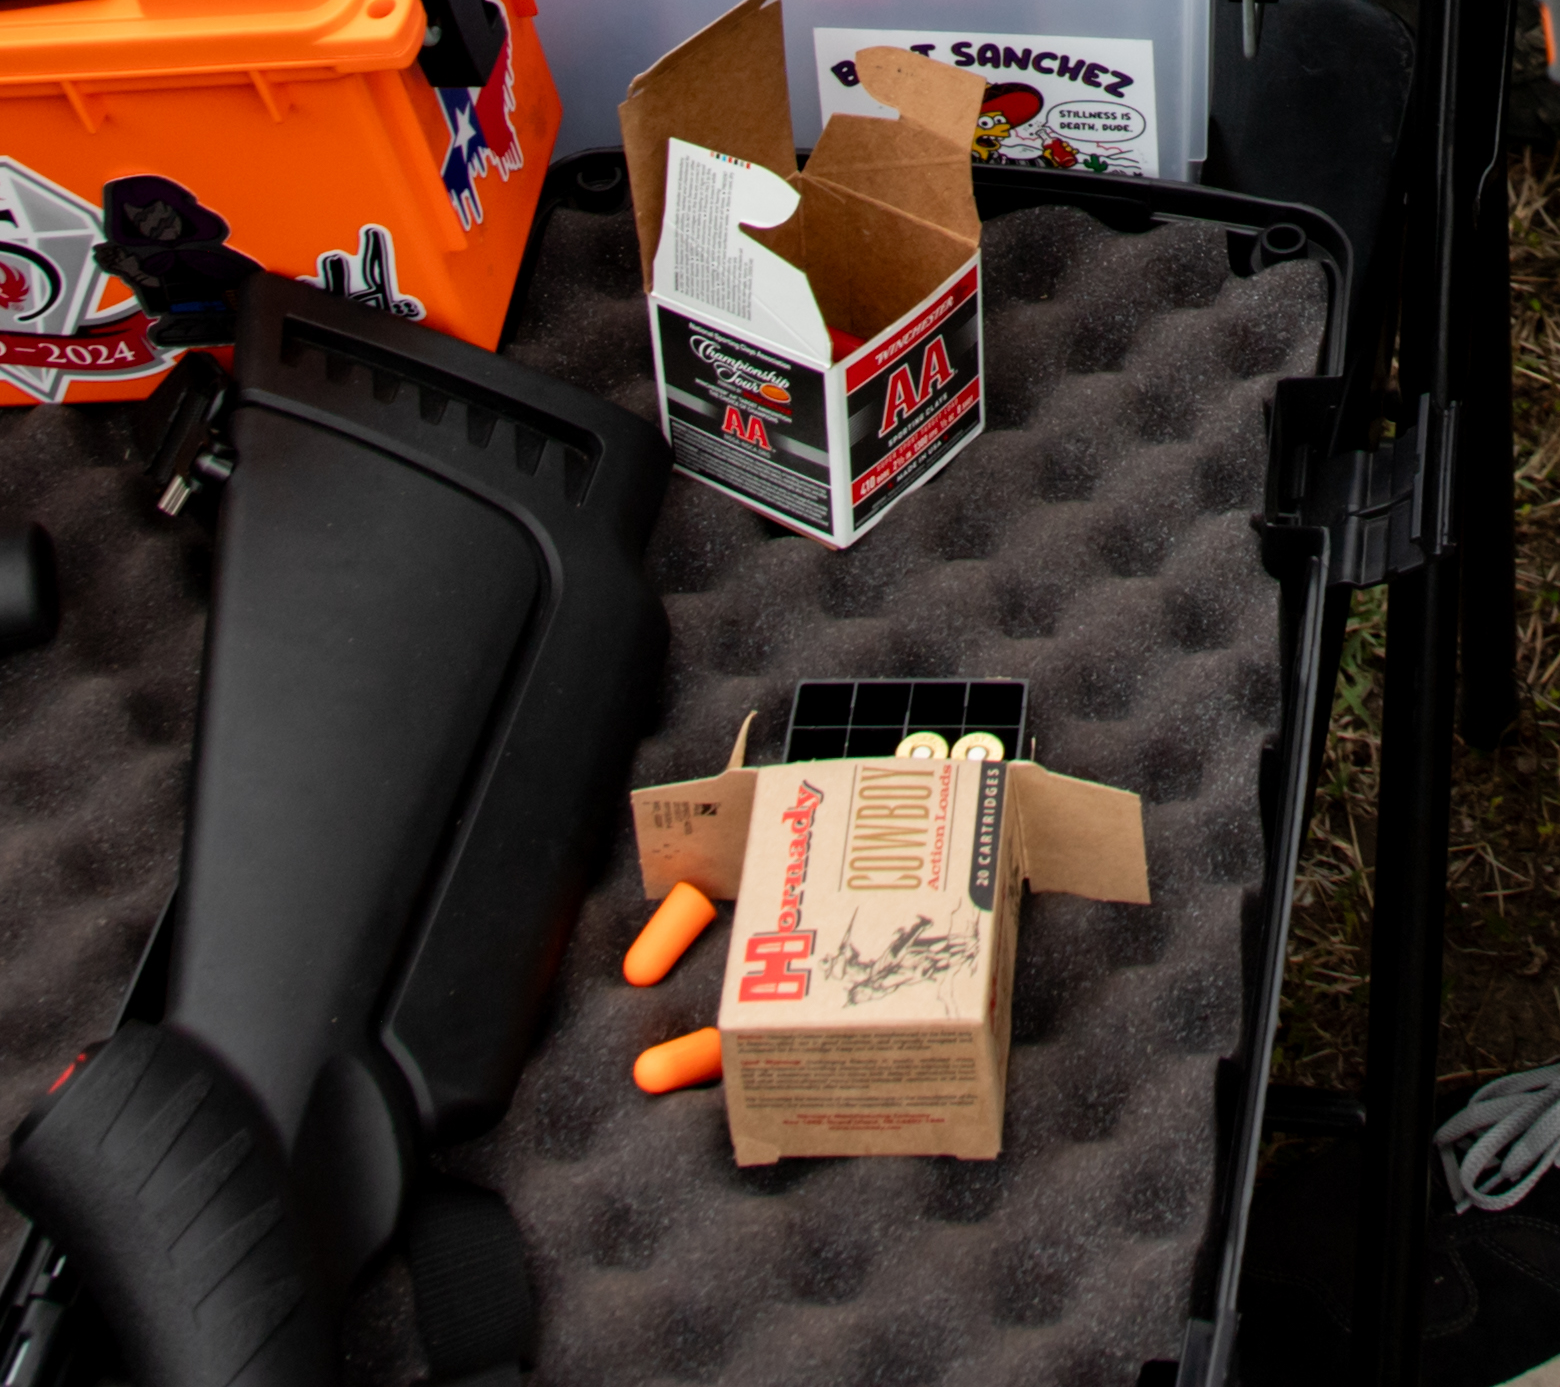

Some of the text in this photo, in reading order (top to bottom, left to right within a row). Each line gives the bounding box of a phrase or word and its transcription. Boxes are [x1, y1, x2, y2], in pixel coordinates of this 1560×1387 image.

[950, 41, 1134, 99] SANCHEZ
[1059, 110, 1131, 121] STILLNESS IS
[1102, 123, 1134, 133] DUDE.
[874, 294, 955, 366] WINCHESTER
[689, 334, 791, 389] Championship
[713, 361, 760, 395] Tour
[878, 333, 956, 439] AA
[722, 405, 772, 452] AA
[887, 392, 948, 448] SPORTING CLAYS
[860, 473, 876, 497] 410
[847, 765, 936, 891] COWBOY
[927, 763, 953, 892] Action Loads
[977, 766, 1000, 868] CARTRIDGES
[738, 778, 824, 1003] Hornady
[975, 871, 989, 887] 20
